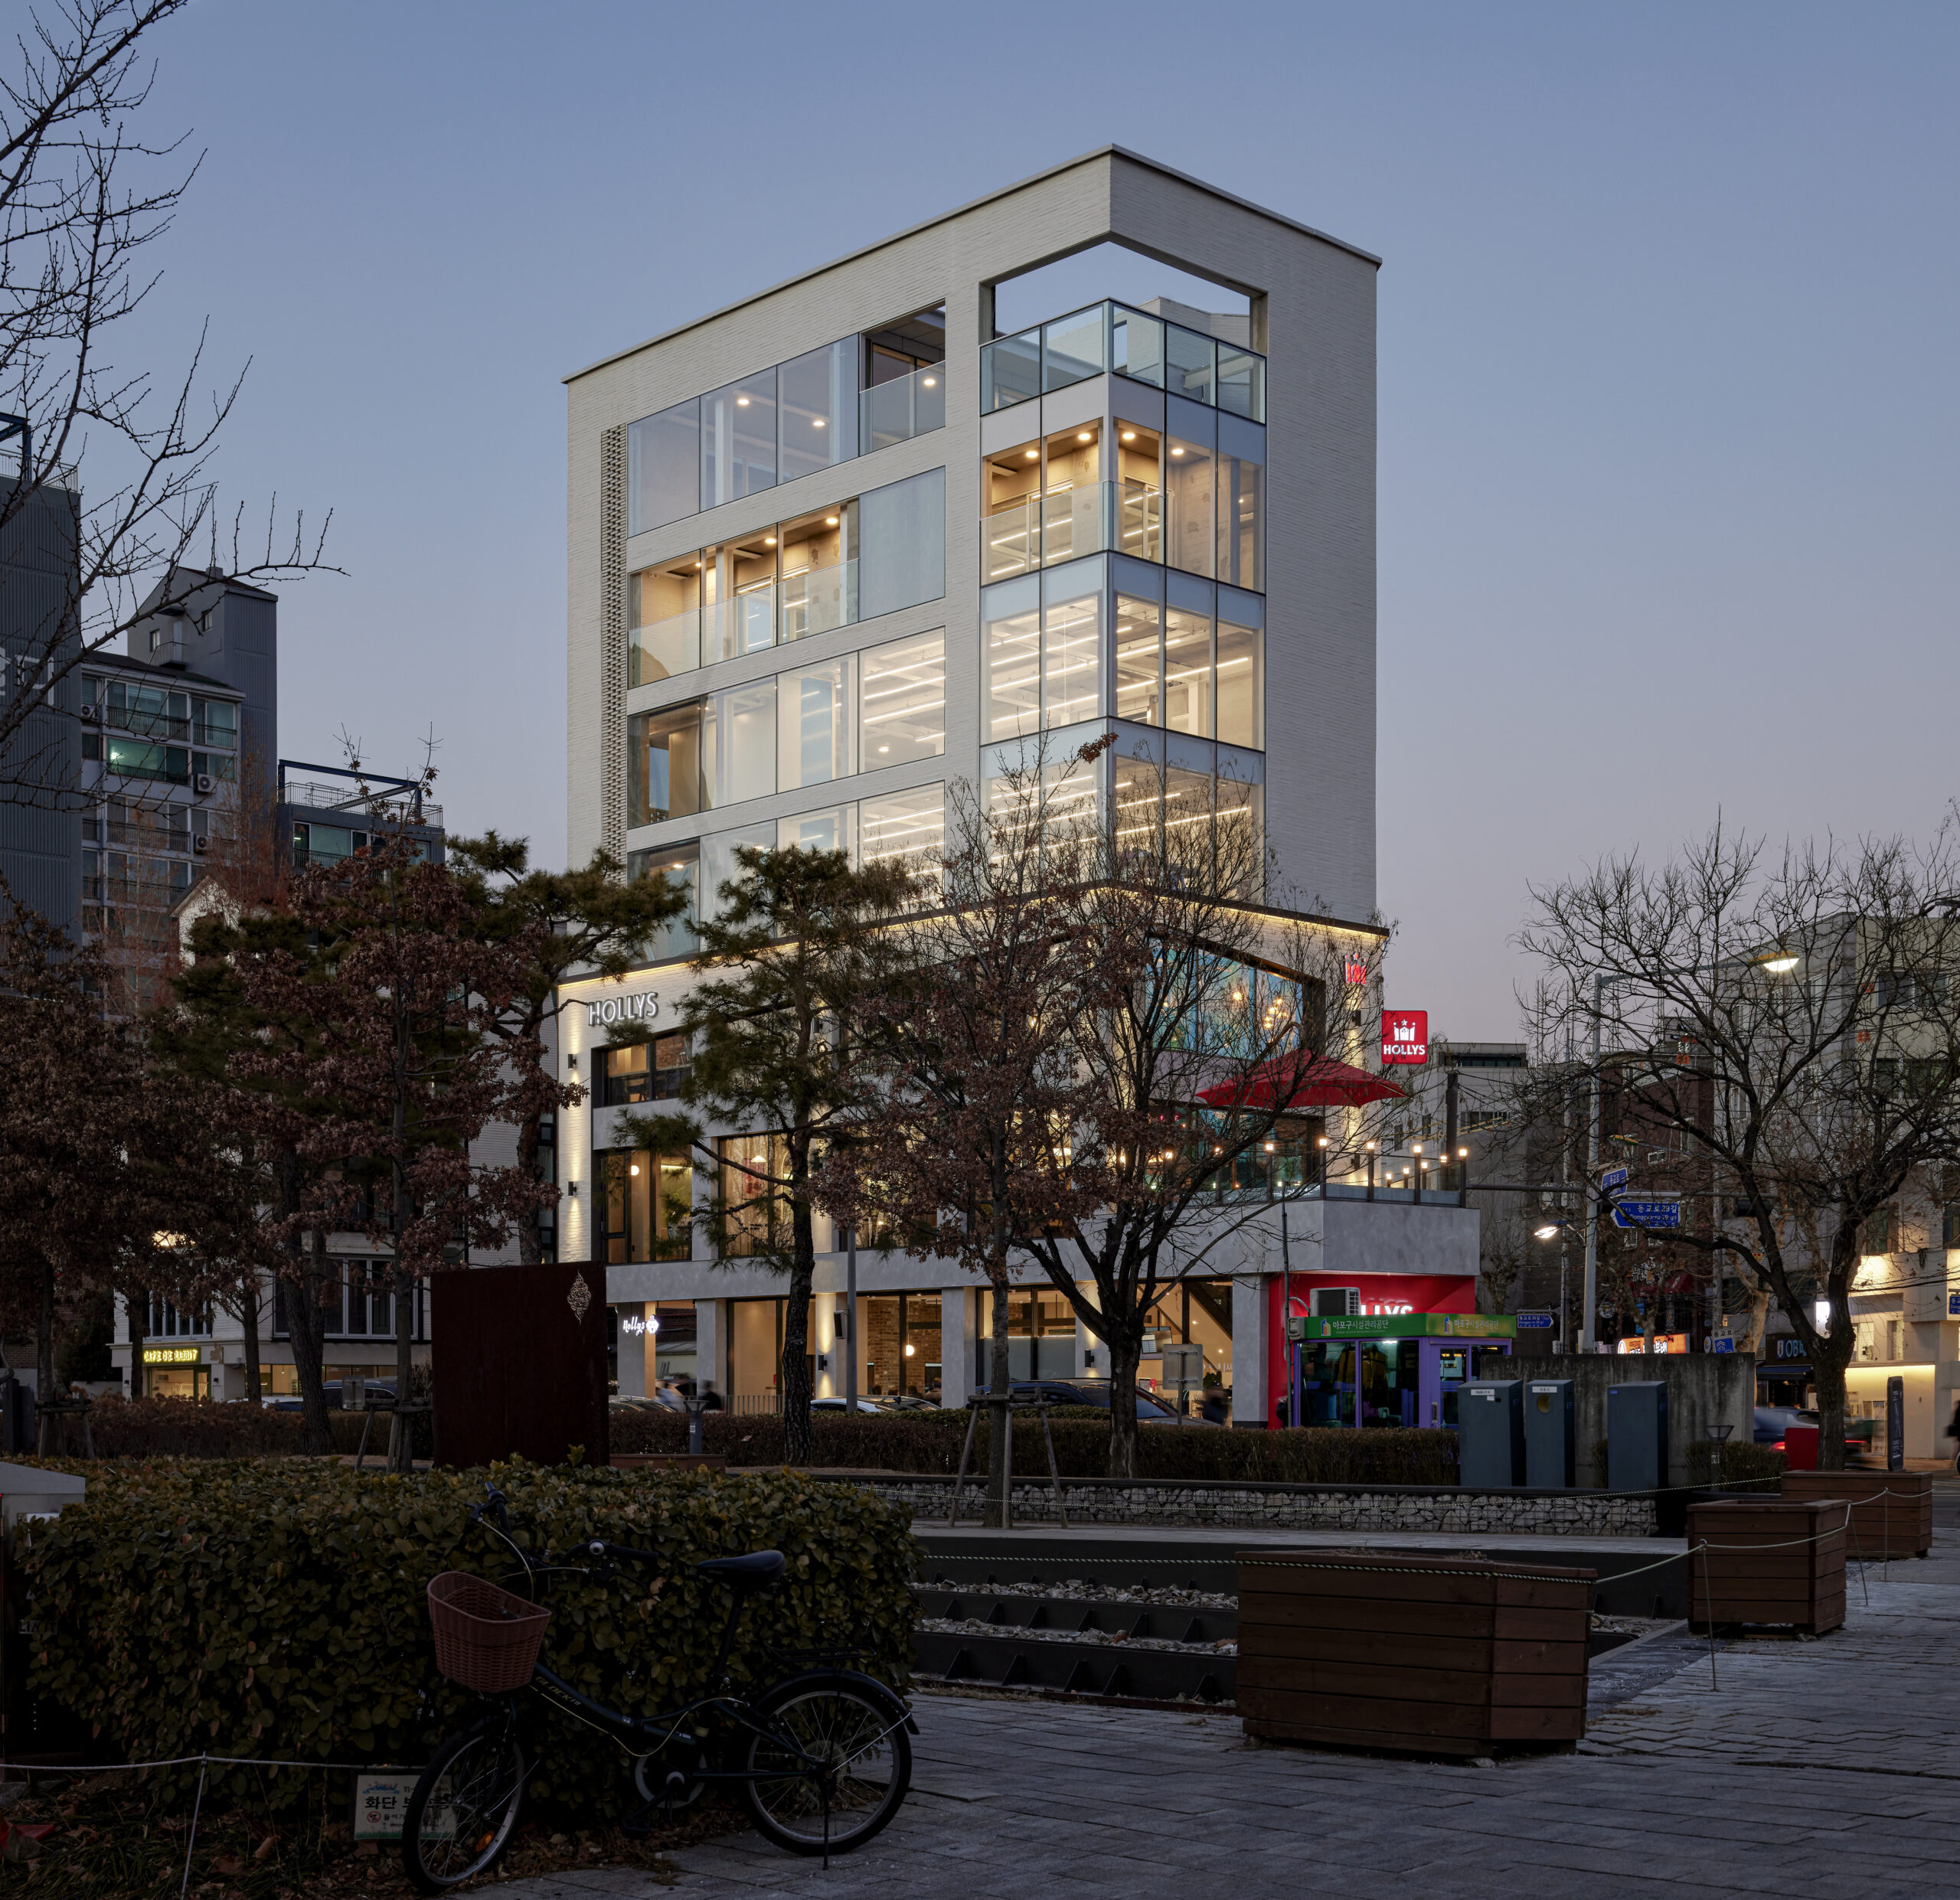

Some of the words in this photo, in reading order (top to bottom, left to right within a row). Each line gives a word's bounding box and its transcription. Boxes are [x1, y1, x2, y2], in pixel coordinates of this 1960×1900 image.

[589, 992, 659, 1027] HOLLYS
[1383, 1044, 1426, 1055] HOLLYS
[622, 1316, 646, 1337] Hollys
[1333, 1320, 1388, 1330] 마포구시설관리공단
[1454, 1318, 1499, 1330] 마포구시설관리공단
[365, 1796, 397, 1810] 화단
